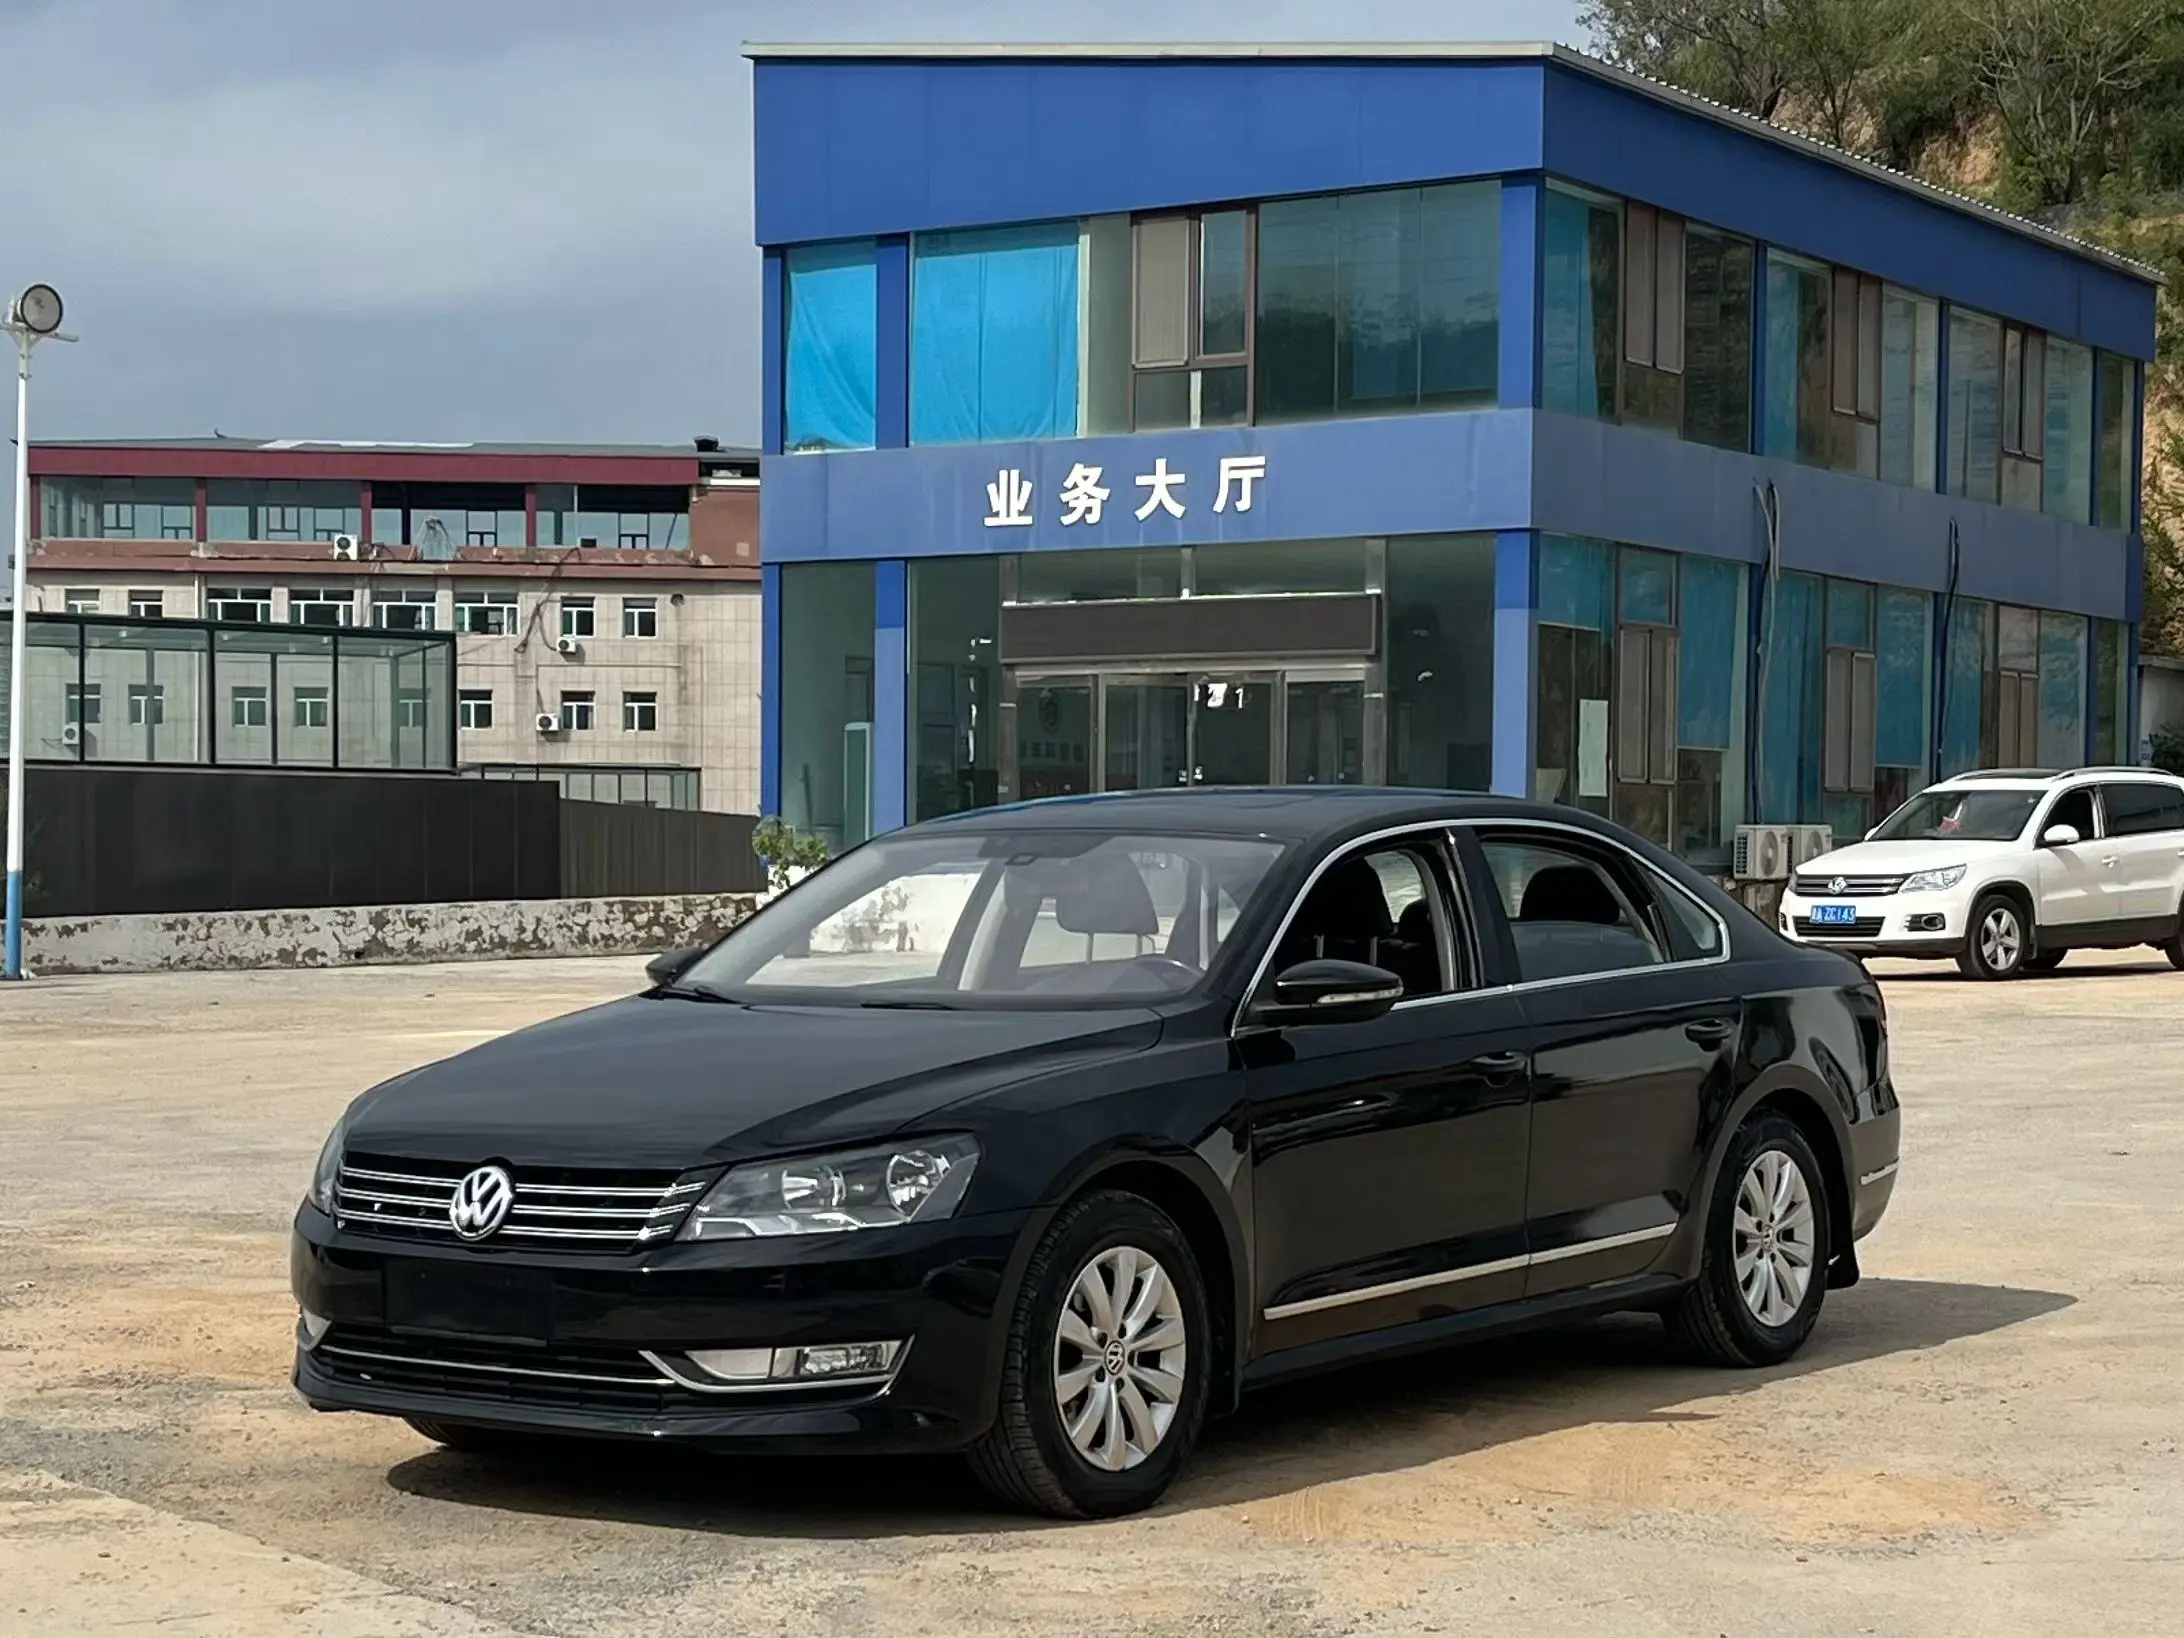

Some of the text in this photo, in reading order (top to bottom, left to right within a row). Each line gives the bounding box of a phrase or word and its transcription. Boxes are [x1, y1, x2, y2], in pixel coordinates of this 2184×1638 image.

[983, 455, 1266, 527] 业务大厅
[450, 1167, 512, 1239] VW
